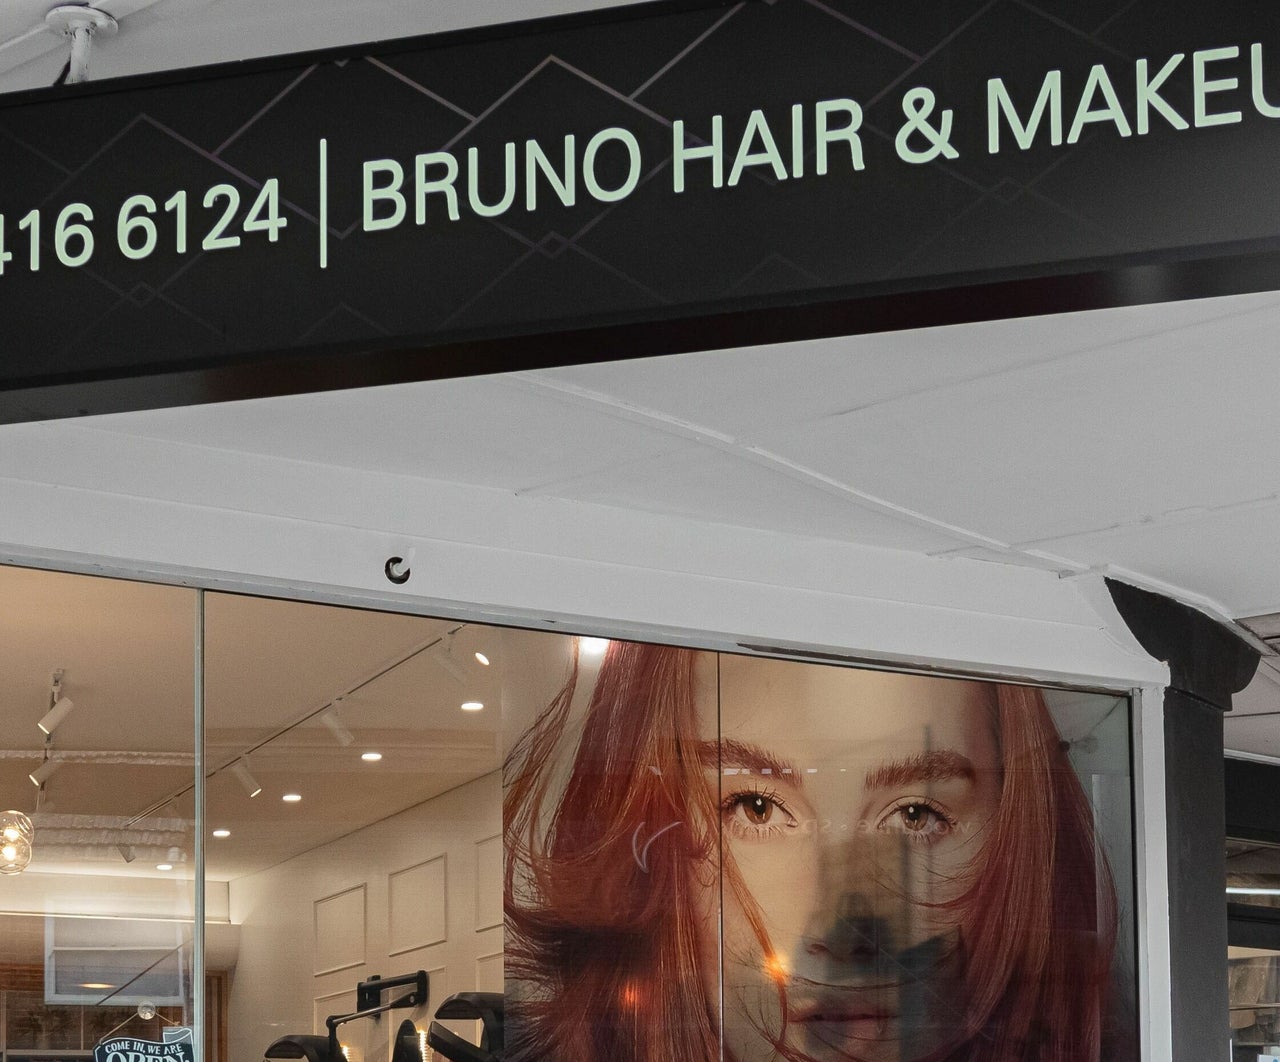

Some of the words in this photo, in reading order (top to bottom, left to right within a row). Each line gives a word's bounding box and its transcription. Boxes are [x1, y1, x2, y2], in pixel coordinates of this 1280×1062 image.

[362, 127, 641, 232] BRUNO
[672, 98, 864, 193] HAIR
[894, 86, 959, 164] &
[117, 178, 288, 260] 6124
[105, 1041, 130, 1053] COME
[133, 1042, 145, 1053] IN,
[148, 1045, 160, 1054] WE
[164, 1043, 182, 1053] ARE
